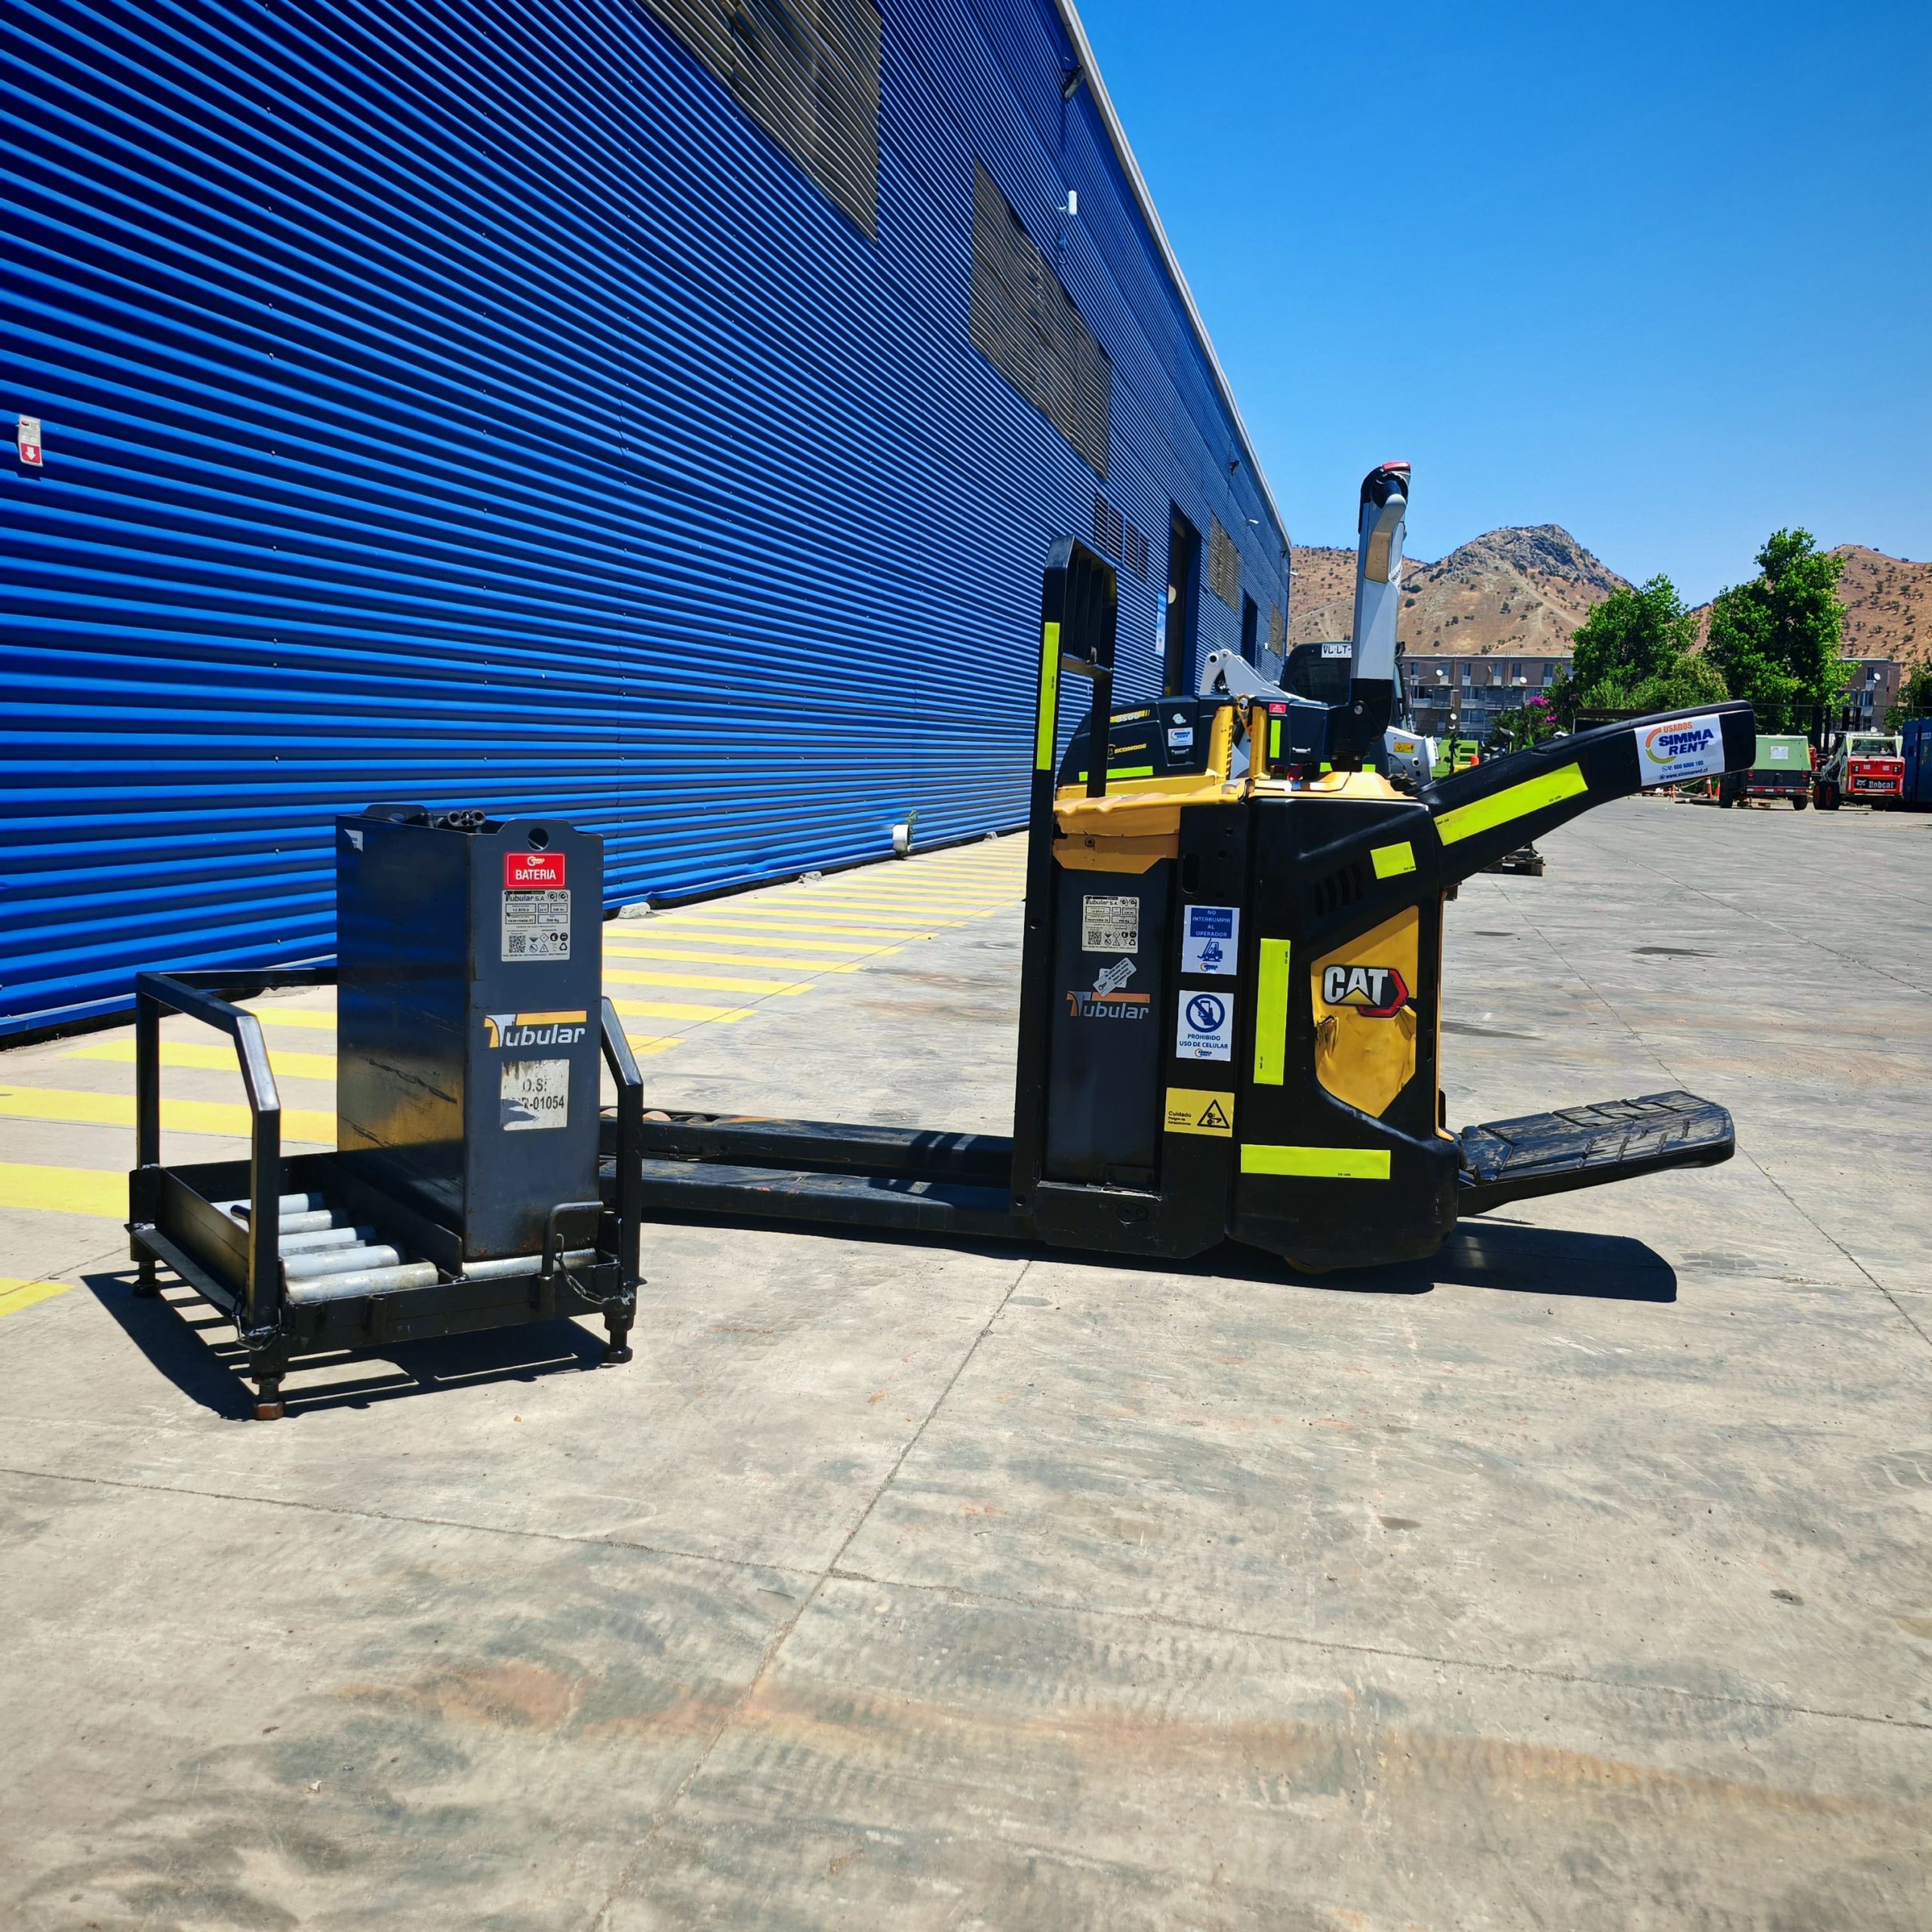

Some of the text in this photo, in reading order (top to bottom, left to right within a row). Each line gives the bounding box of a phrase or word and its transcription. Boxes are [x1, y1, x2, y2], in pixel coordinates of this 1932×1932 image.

[1663, 721, 1693, 733] USADOS
[1658, 728, 1714, 747] SIMMA
[1669, 740, 1709, 755] RENT
[1869, 780, 1894, 789] Bobcat
[515, 869, 556, 881] BATERIA
[1324, 966, 1389, 1005] CAT
[1066, 991, 1149, 1020] Tubular
[484, 1014, 586, 1048] Tubular
